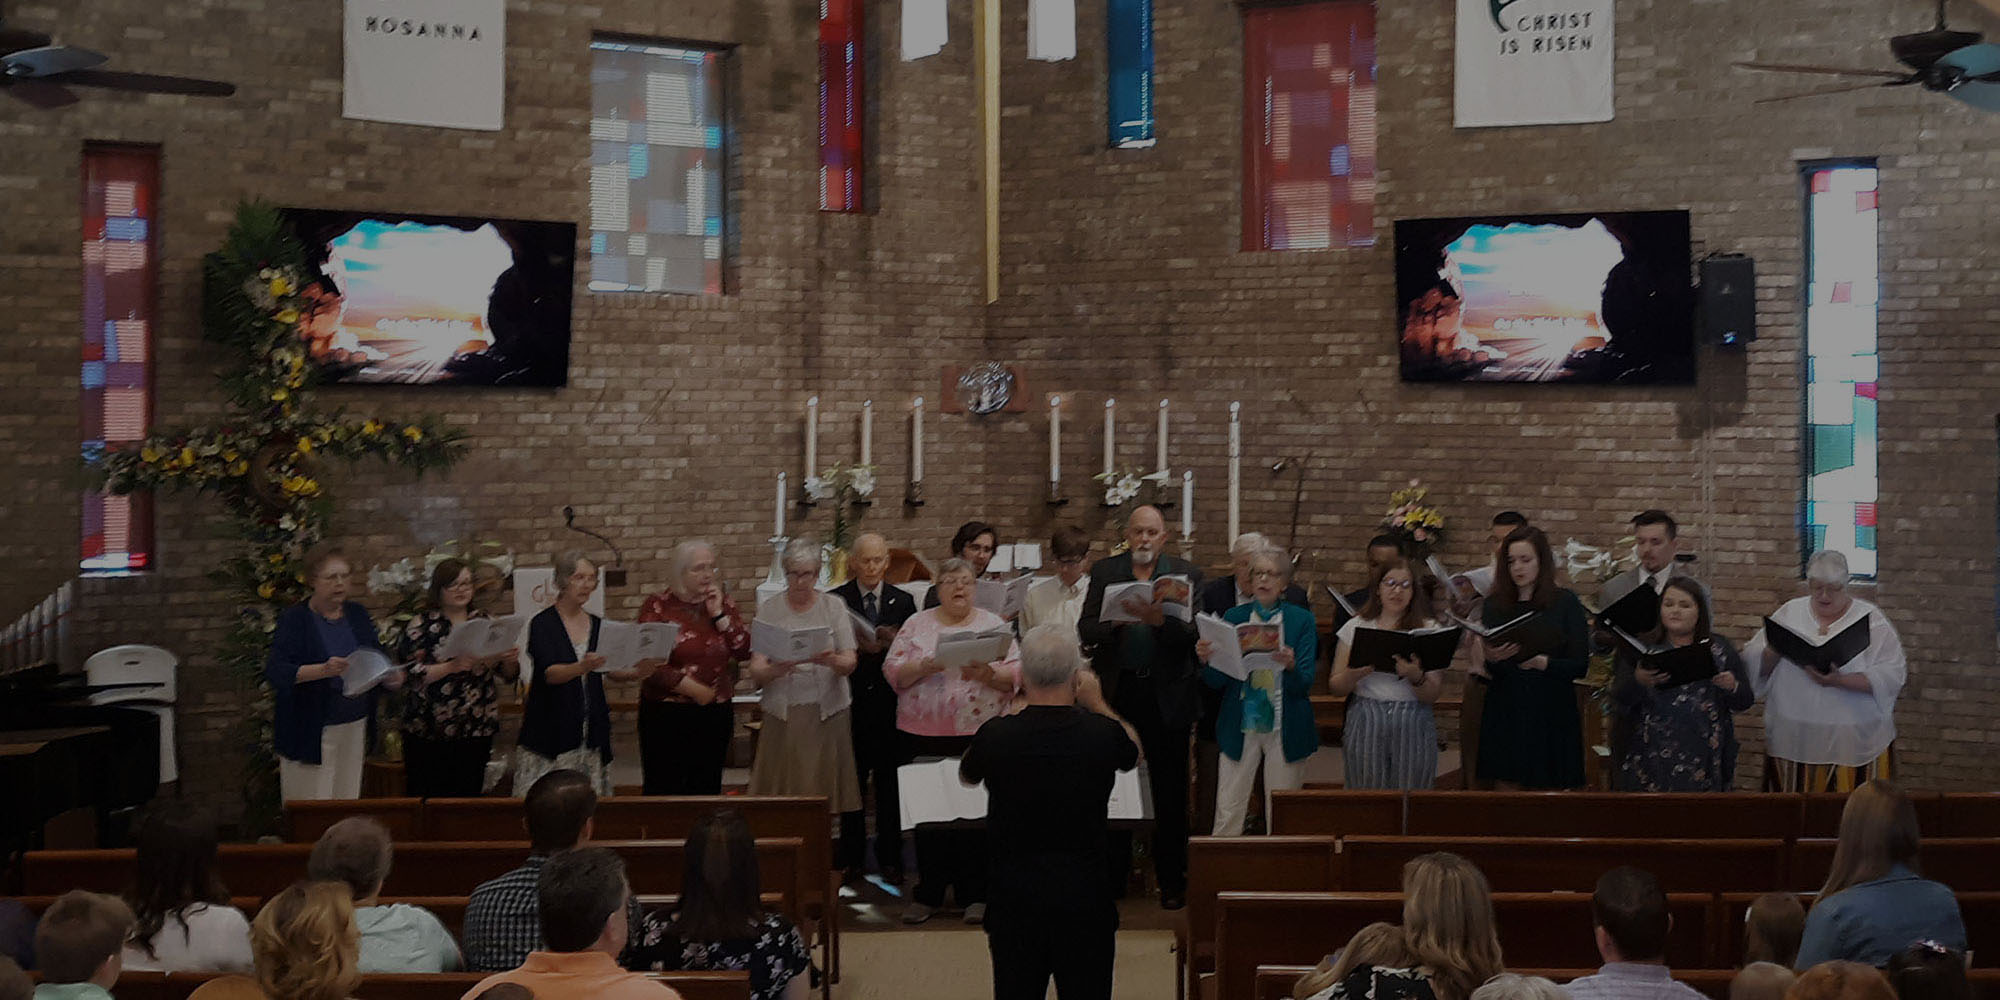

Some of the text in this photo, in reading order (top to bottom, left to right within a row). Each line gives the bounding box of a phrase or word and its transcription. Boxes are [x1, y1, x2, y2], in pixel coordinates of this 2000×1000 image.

[365, 15, 482, 42] HOSANNA
[1517, 12, 1593, 32] CHRIST
[1500, 36, 1594, 55] IS RISEN
